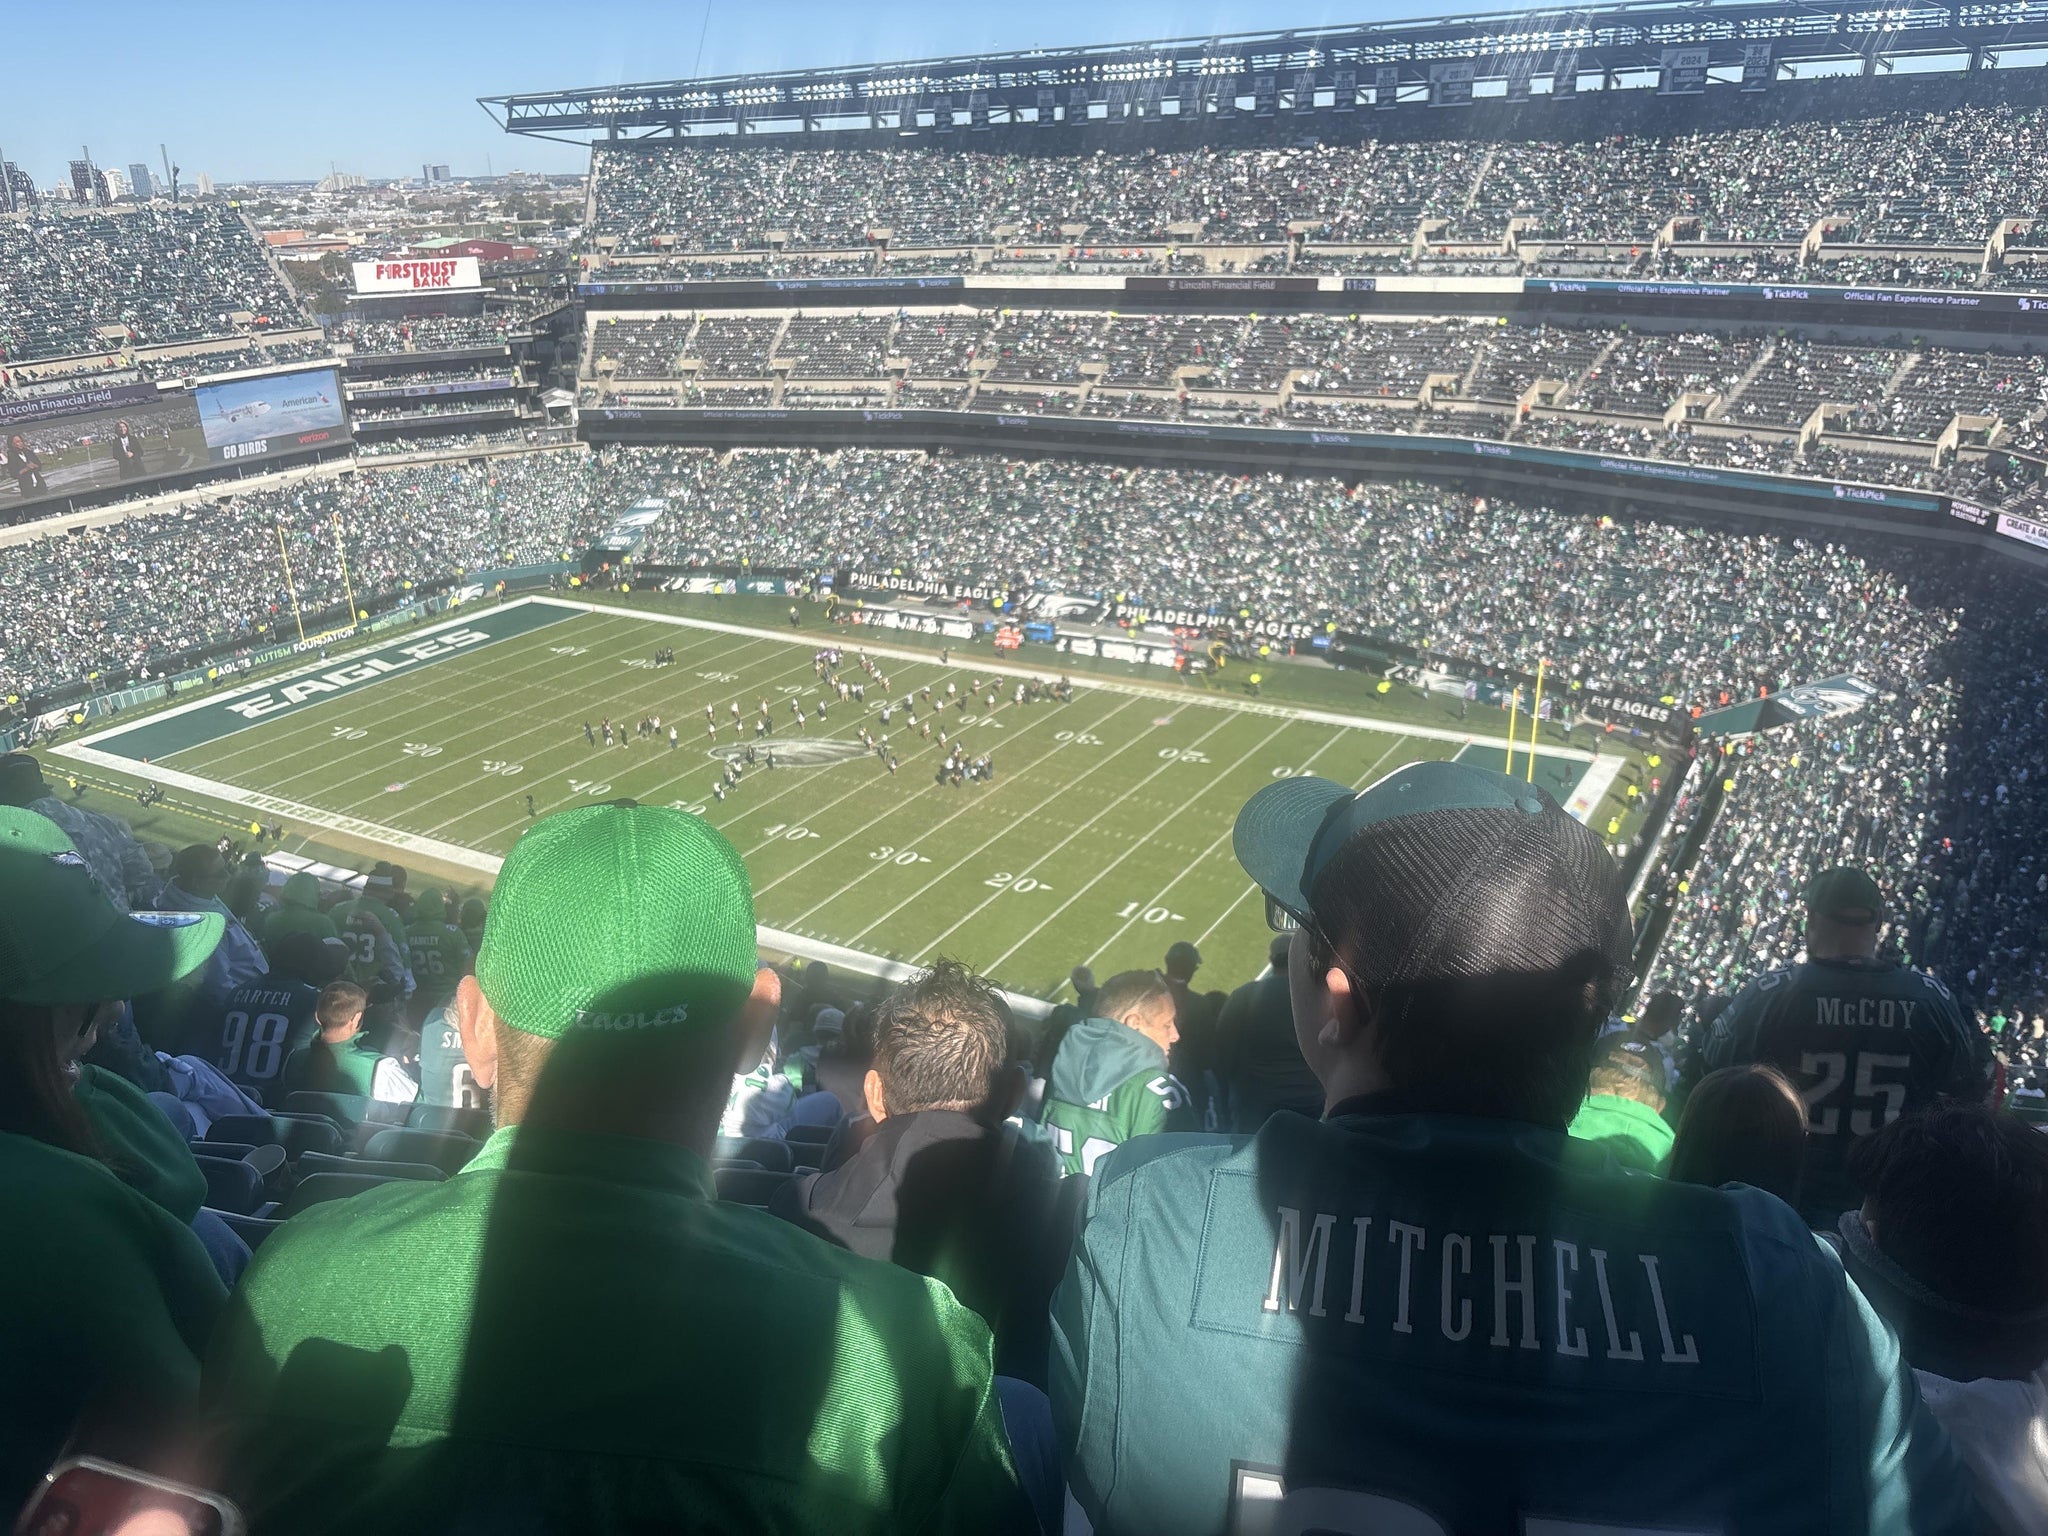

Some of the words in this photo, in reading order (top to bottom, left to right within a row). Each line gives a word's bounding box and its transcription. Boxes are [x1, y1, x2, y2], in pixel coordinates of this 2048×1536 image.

[1680, 56, 1702, 66] 2024
[413, 276, 451, 288] BANK
[1179, 280, 1211, 290] Lincoln
[1212, 280, 1251, 290] Financial
[1253, 280, 1276, 290] Field
[1345, 279, 1375, 291] 11:29
[1559, 284, 1587, 292] TickPick
[1617, 285, 1644, 293] Official
[1659, 286, 1700, 295] Experience
[1701, 287, 1730, 296] Partner
[1774, 289, 1809, 299] TickPick
[1843, 291, 1875, 302] Official
[1876, 293, 1892, 302] Fan
[1894, 293, 1944, 305] Experience
[1946, 296, 1980, 306] Partner
[0, 403, 39, 416] Lincoln
[40, 394, 86, 409] Financial
[87, 390, 112, 403] Field
[282, 395, 318, 408] American
[223, 444, 236, 460] GO
[238, 440, 268, 457] BIRDS
[298, 432, 330, 444] verizon
[1600, 460, 1627, 470] Official
[1643, 464, 1687, 478] Experience
[1688, 470, 1718, 480] Partner
[1846, 488, 1887, 501] TickPick
[2006, 518, 2031, 533] CREATE
[2030, 526, 2036, 535] A
[850, 572, 949, 597] PHILADELPHIA
[954, 585, 1009, 604] EAGLES
[1116, 604, 1236, 629] PHILADELPHIA
[1245, 619, 1313, 640] EAGLES
[254, 647, 292, 665] AUTISM
[293, 629, 355, 654] FOUNDATION
[224, 628, 491, 718] EAGLES
[1611, 697, 1670, 722] EAGLES
[339, 820, 414, 844] CANCER
[869, 845, 919, 865] 30
[984, 872, 1038, 892] 20
[1116, 902, 1170, 924] 10
[411, 949, 445, 976] 26
[233, 988, 292, 1006] CARTER
[575, 1003, 689, 1031] EAGLES
[1816, 997, 1917, 1030] McCOY
[217, 1010, 289, 1079] 98
[1800, 1051, 1912, 1137] 25
[1261, 1205, 1700, 1364] MITCHELL
